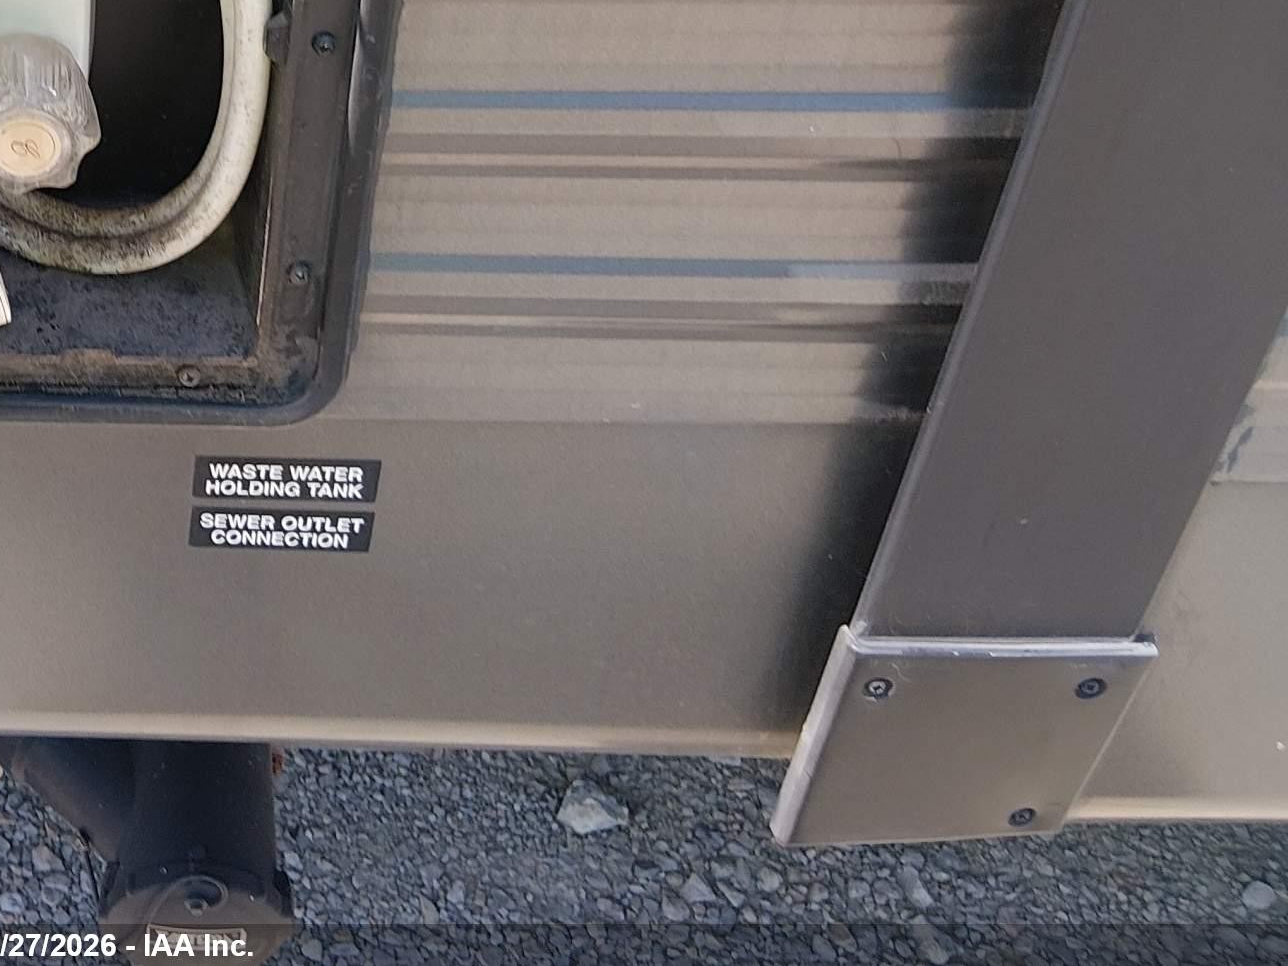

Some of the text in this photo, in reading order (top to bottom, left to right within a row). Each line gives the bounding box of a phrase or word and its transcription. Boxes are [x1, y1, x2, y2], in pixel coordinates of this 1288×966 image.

[209, 463, 364, 483] WASTE WATER
[205, 480, 363, 499] HOLDING TANK
[199, 512, 365, 534] SEWER OUTLET
[210, 529, 348, 549] CONNECTION
